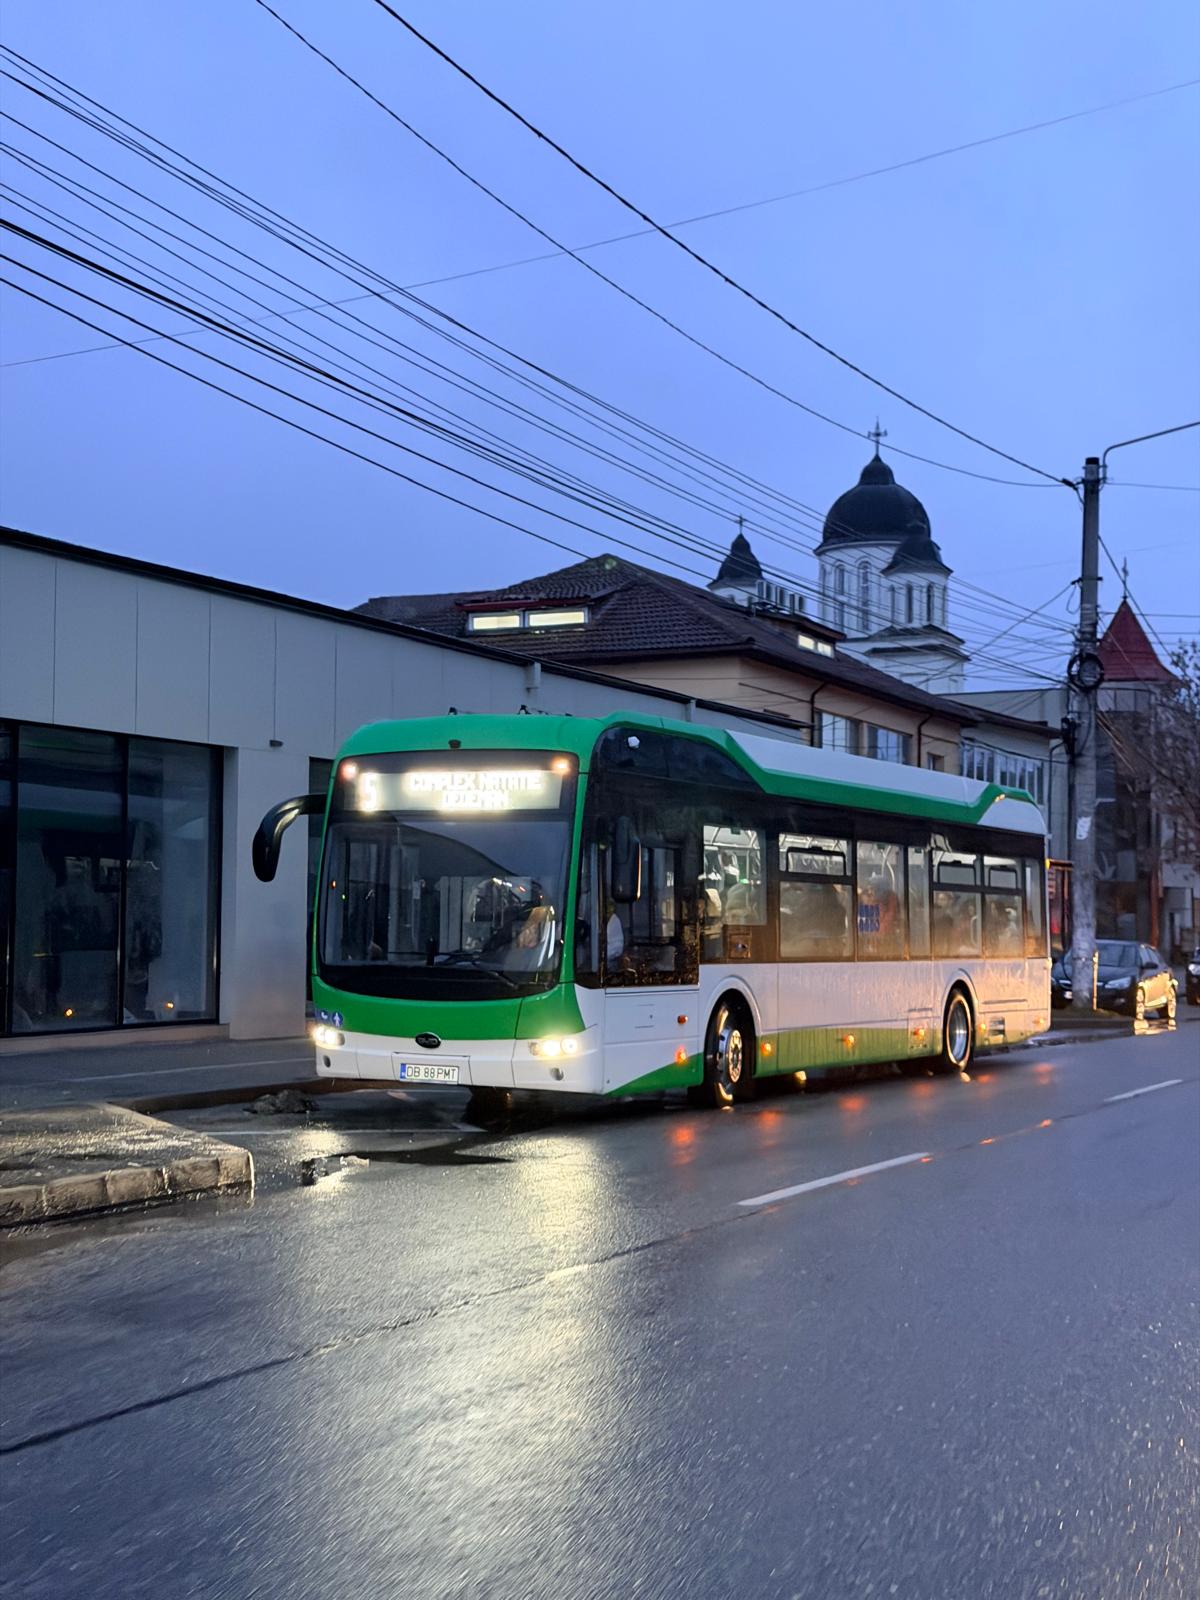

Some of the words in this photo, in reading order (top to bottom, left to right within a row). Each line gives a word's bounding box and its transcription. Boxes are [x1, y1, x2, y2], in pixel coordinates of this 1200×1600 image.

[363, 773, 379, 811] 5
[409, 773, 475, 792] COMPLEX
[406, 1066, 420, 1077] DB
[423, 1067, 436, 1078] 88
[437, 1068, 456, 1080] PMT
